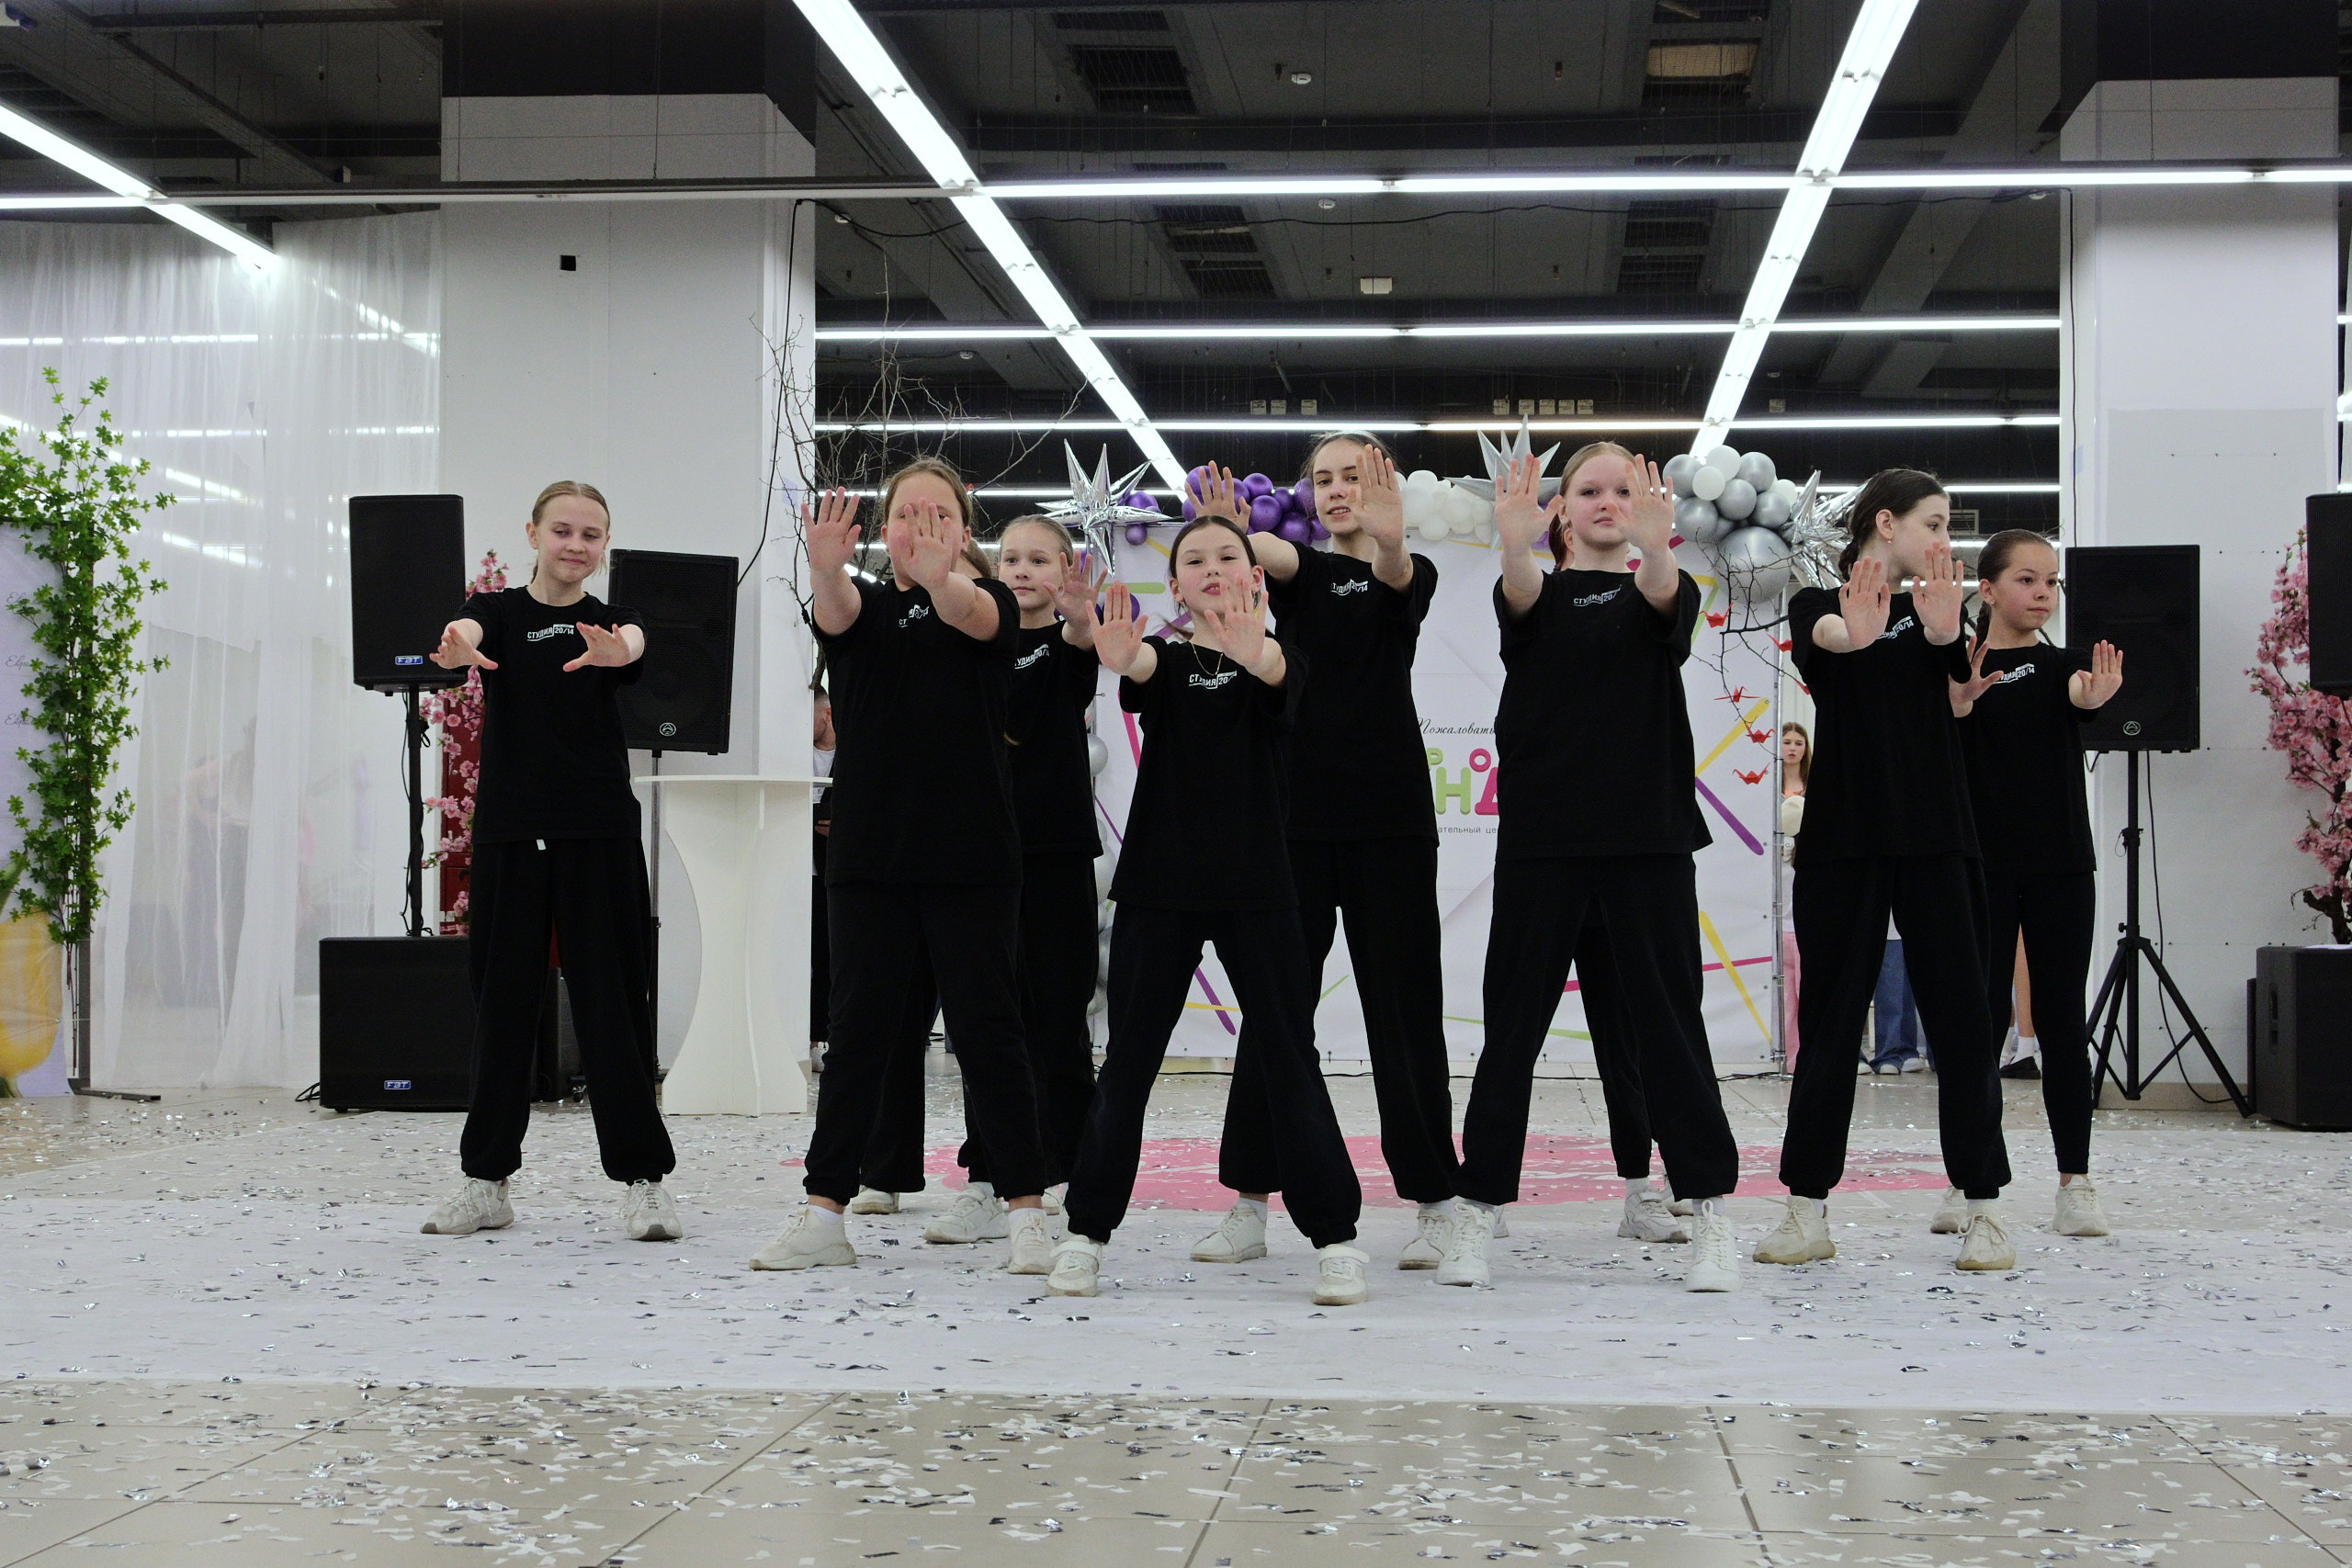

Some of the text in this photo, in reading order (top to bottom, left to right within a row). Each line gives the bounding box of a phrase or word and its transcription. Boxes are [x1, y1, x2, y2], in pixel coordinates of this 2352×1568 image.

[526, 627, 553, 639] СТУДИЯ
[2018, 667, 2035, 678] 20/14
[1437, 826, 1481, 834] ательный
